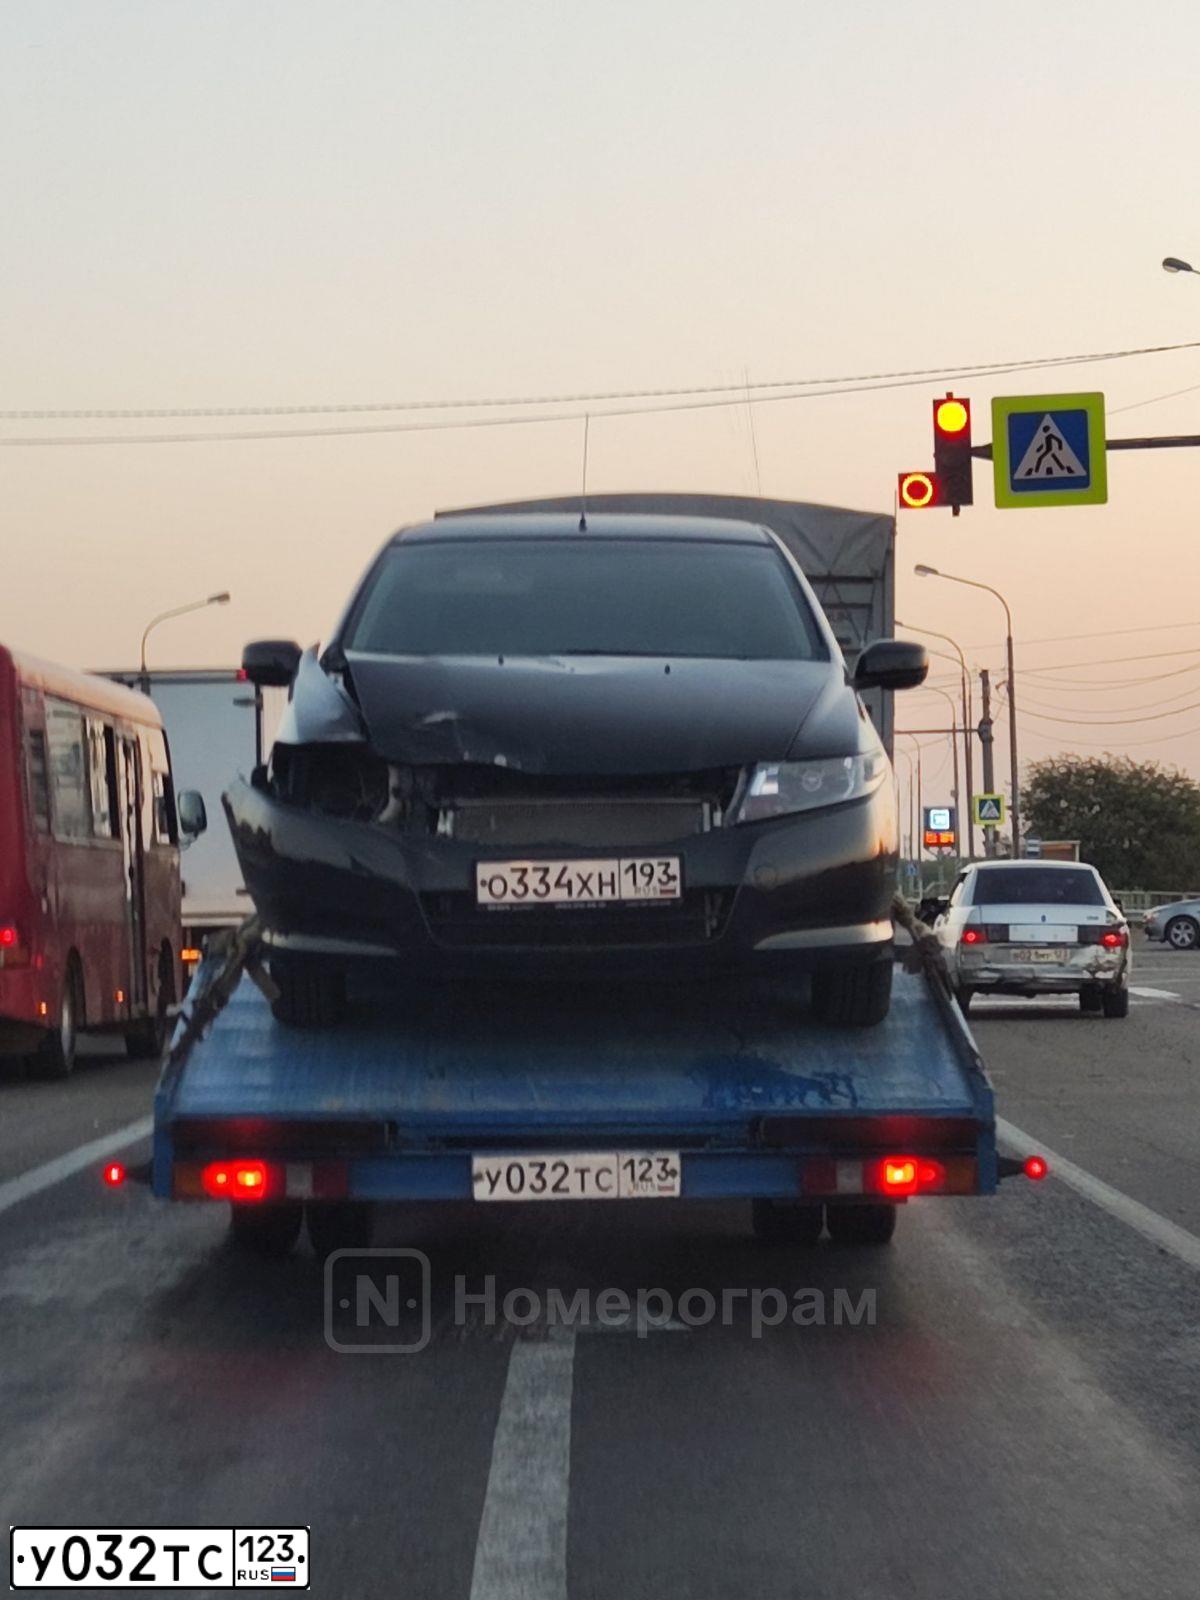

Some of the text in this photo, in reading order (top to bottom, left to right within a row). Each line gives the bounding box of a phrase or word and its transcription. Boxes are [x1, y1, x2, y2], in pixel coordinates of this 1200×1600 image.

[488, 861, 672, 899] О334ХН 193
[485, 1157, 670, 1194] У032ТС 123
